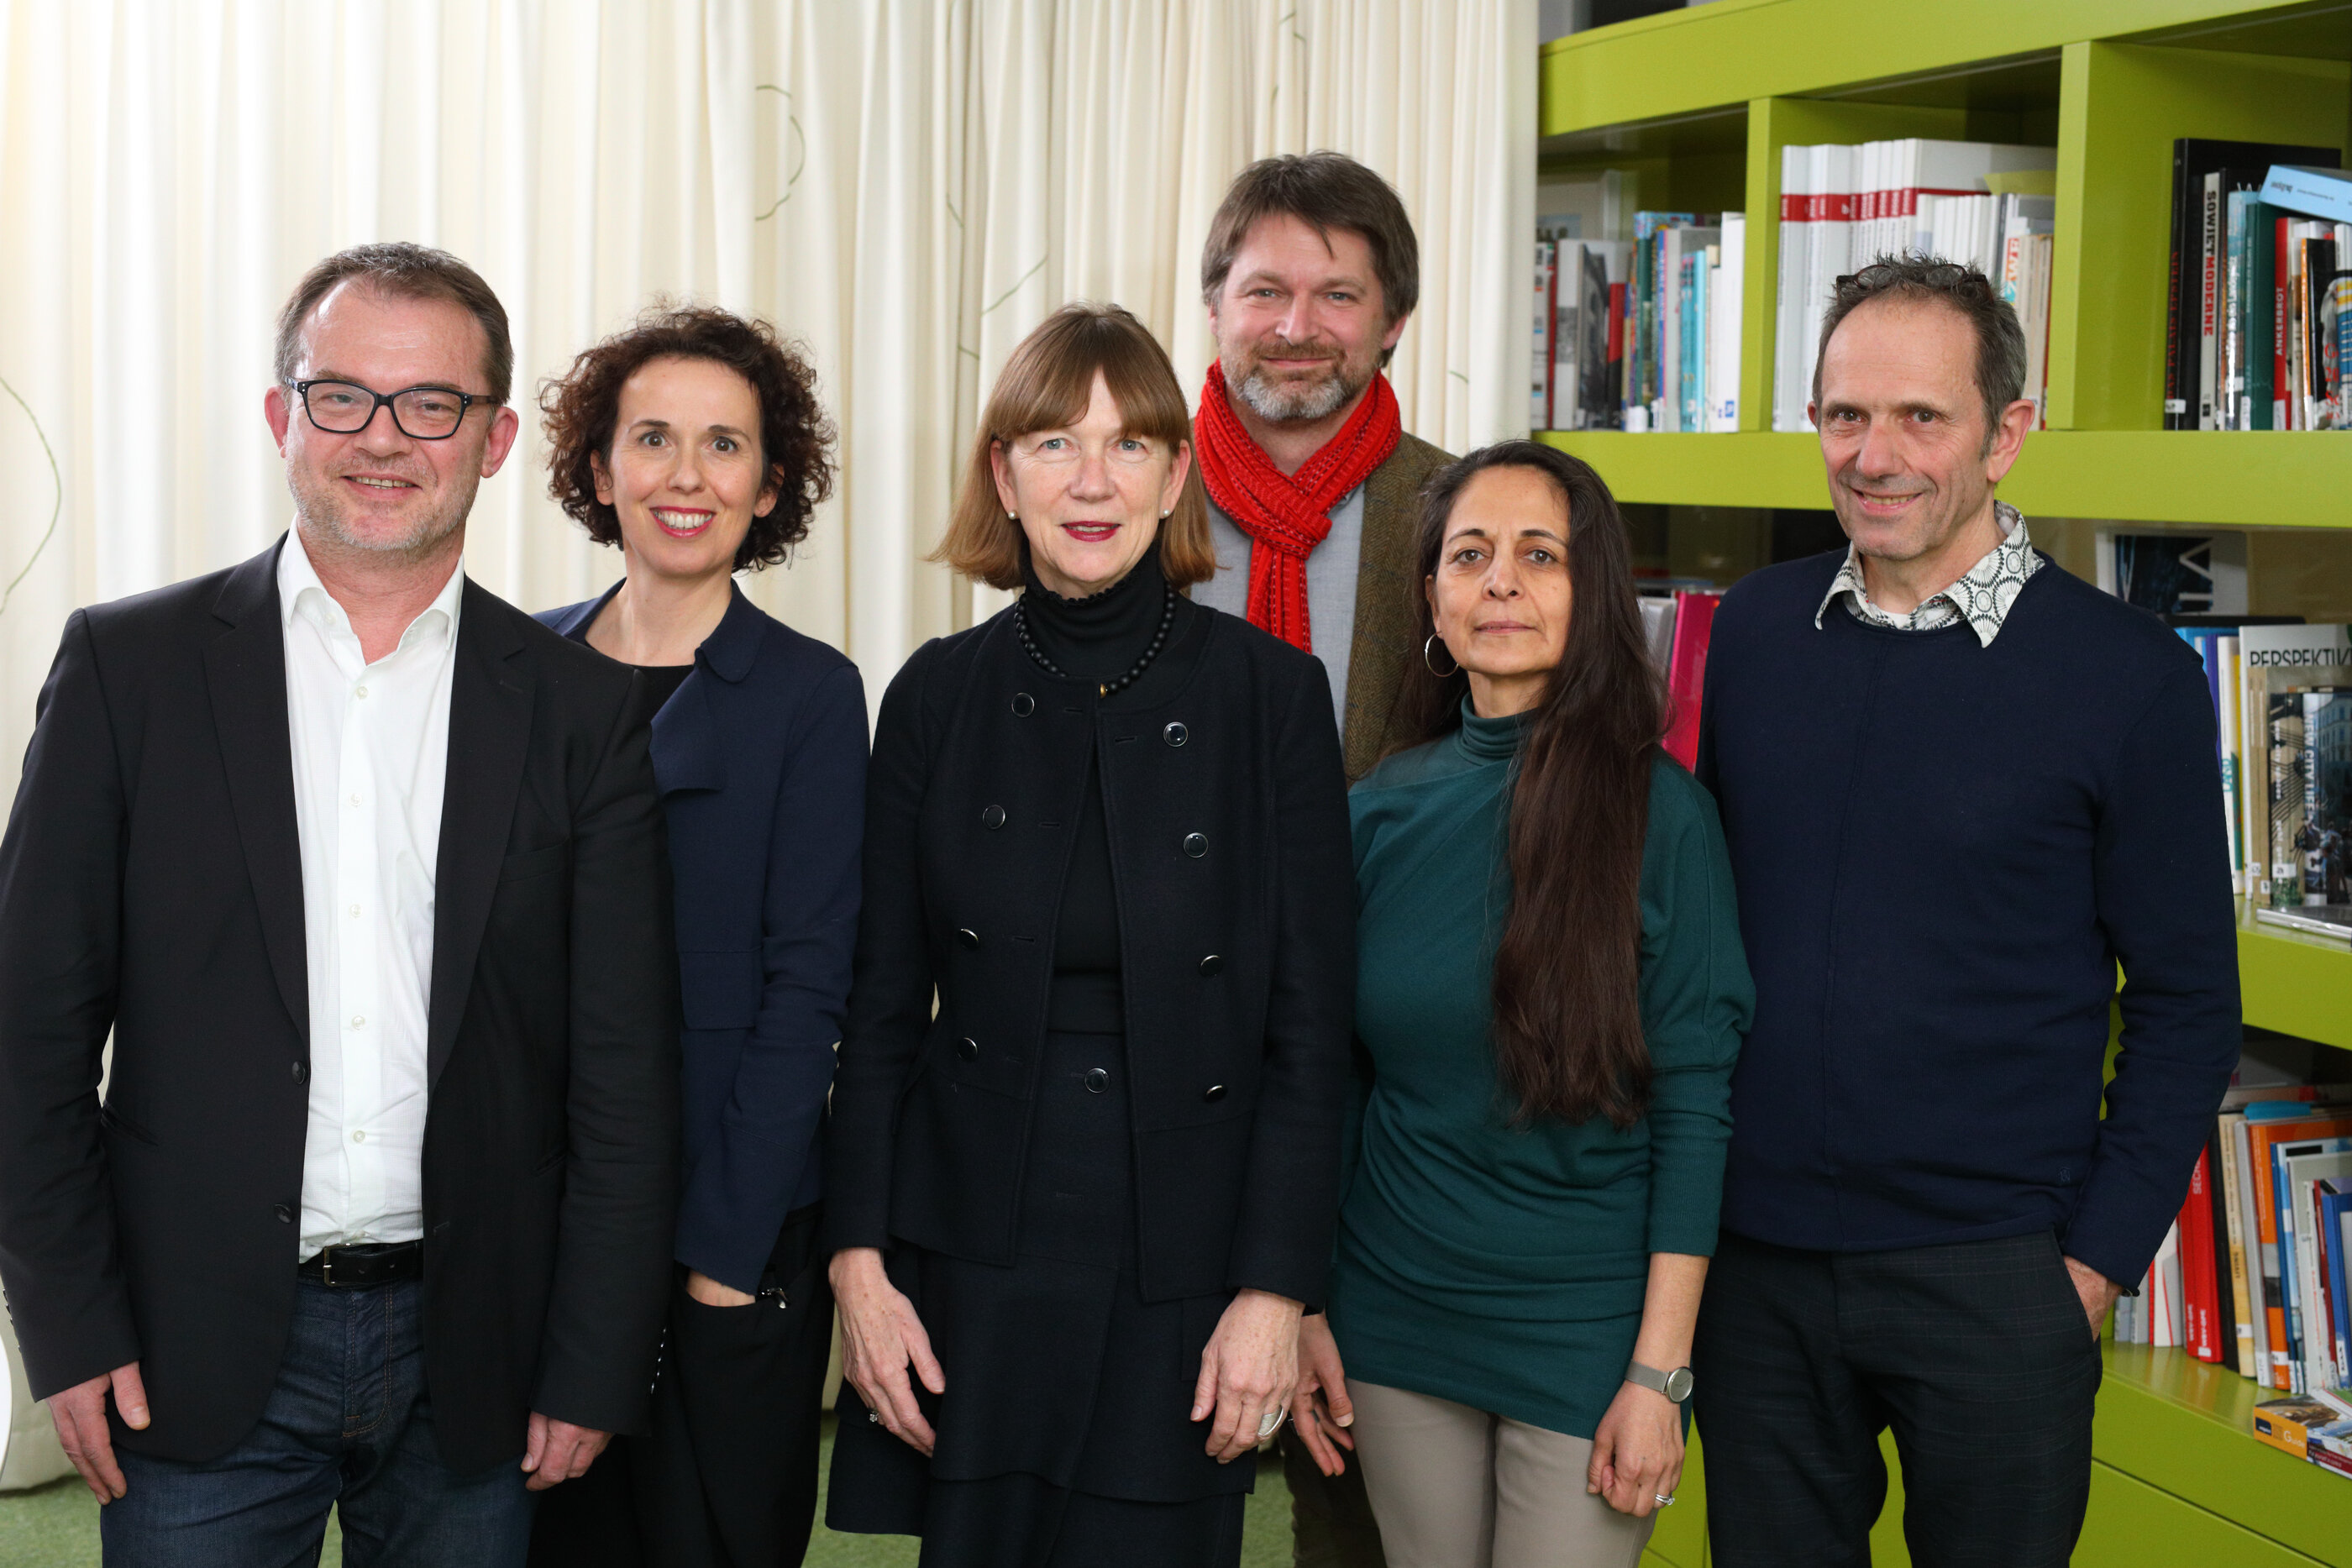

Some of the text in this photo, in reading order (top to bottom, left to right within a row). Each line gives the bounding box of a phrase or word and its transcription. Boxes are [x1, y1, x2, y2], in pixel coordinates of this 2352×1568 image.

[2275, 286, 2284, 356] ANKERBROT
[2250, 647, 2352, 666] PERSPEKTIV
[2304, 713, 2315, 810] NEW CITY LIFE
